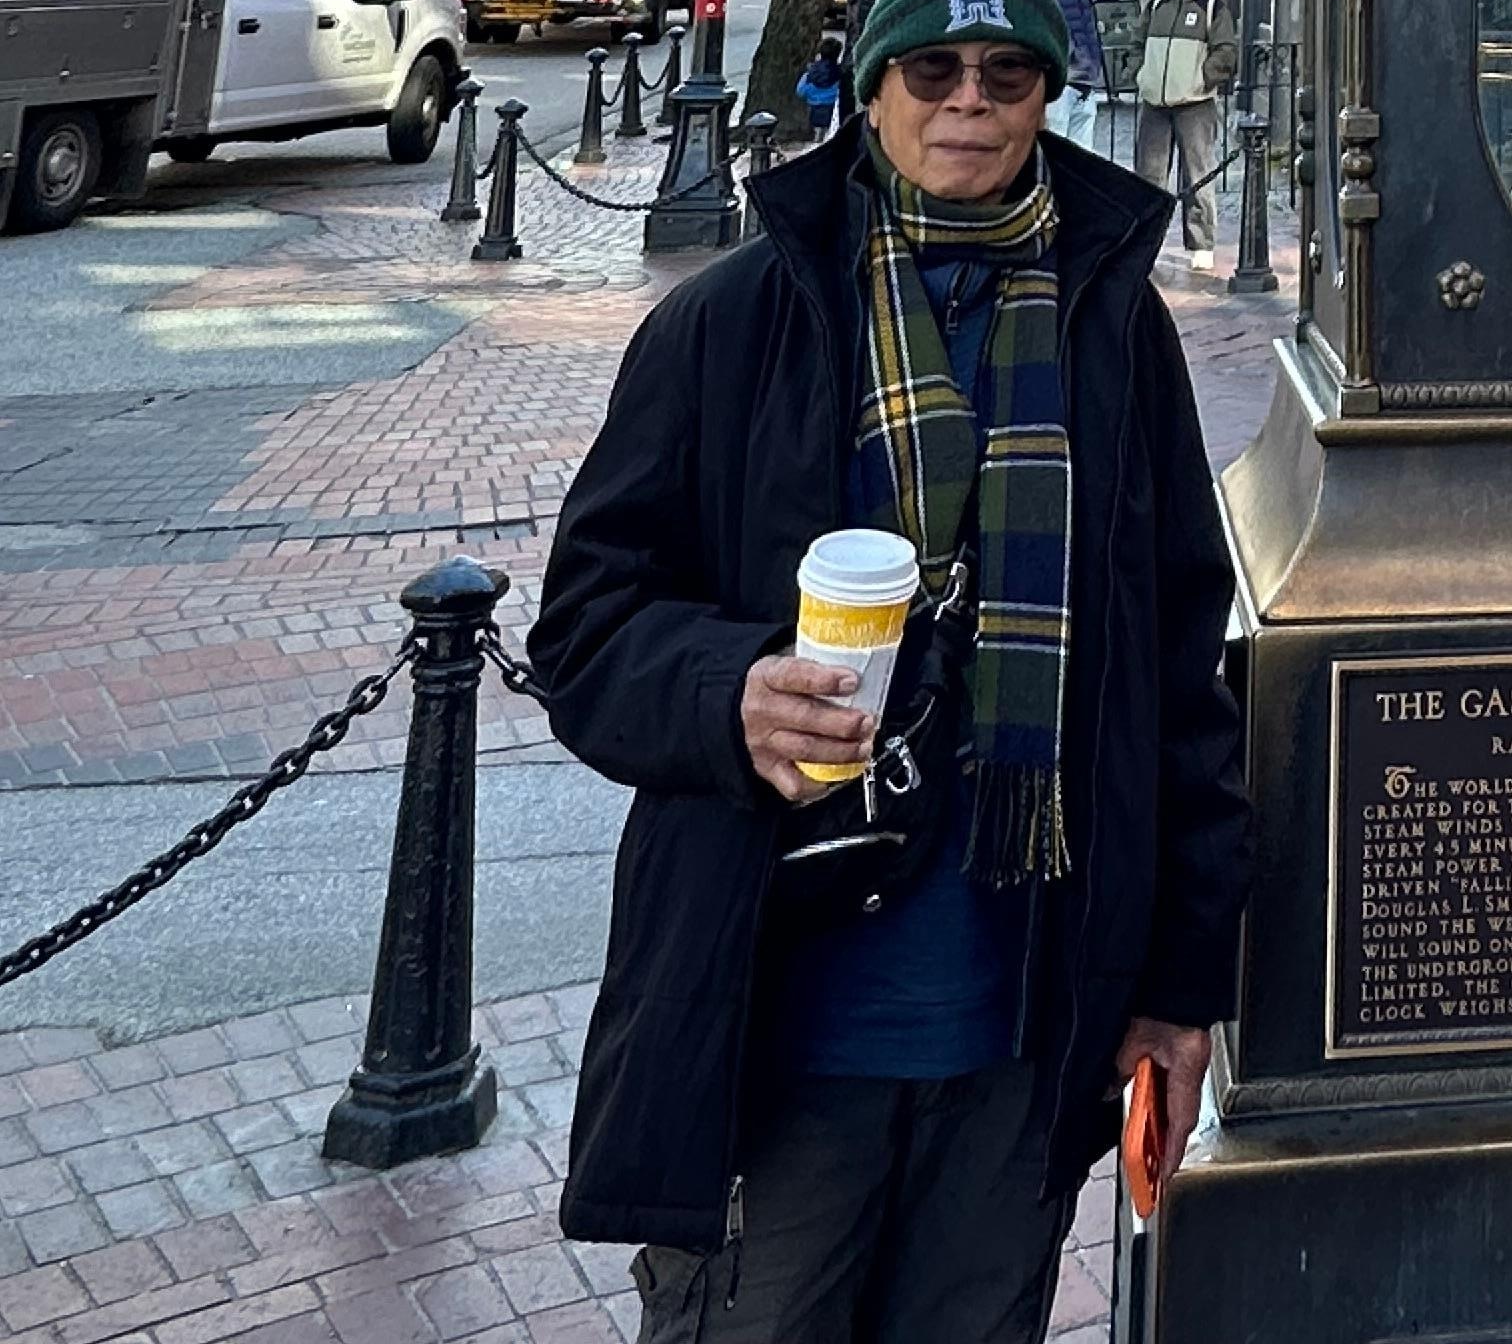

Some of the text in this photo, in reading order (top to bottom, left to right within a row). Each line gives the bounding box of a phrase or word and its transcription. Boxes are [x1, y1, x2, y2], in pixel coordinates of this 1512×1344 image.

[1376, 691, 1445, 721] THE
[1385, 766, 1438, 798] THE
[1363, 802, 1451, 820] CREATED
[1463, 800, 1500, 816] FOR
[1364, 822, 1425, 839] STEAM
[1438, 819, 1503, 835] WINDS
[1363, 842, 1425, 859] EVERY
[1362, 861, 1424, 878] STEAM
[1435, 857, 1502, 874] POWER
[1362, 880, 1440, 898] DRIVEN
[1362, 900, 1451, 919] DOUGLAS
[1462, 895, 1479, 913] L.
[1362, 921, 1427, 939] SOUND
[1440, 918, 1475, 935] THE
[1363, 942, 1408, 959] WILL
[1418, 939, 1481, 957] SOUND
[1362, 965, 1398, 981] THE
[1361, 982, 1450, 1001] LIMITED.
[1464, 979, 1499, 995] THE
[1361, 1004, 1425, 1022] CLOCK
